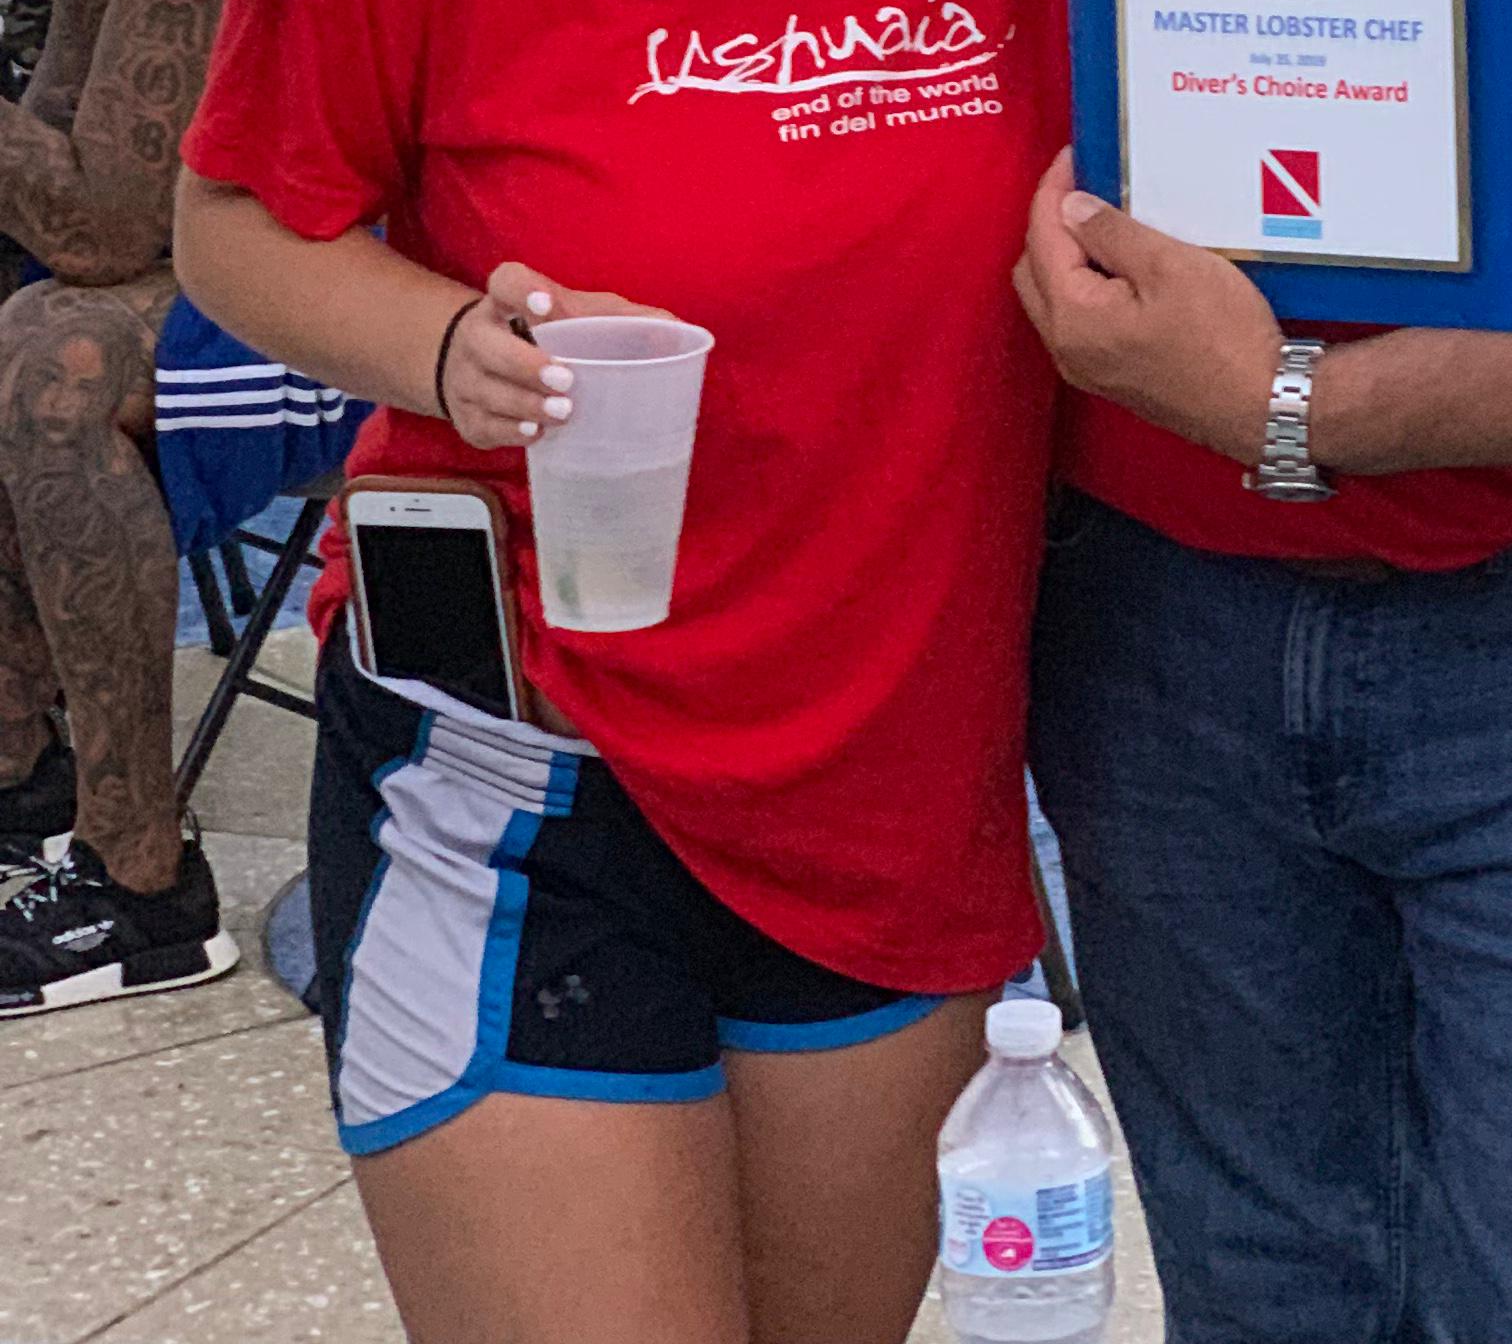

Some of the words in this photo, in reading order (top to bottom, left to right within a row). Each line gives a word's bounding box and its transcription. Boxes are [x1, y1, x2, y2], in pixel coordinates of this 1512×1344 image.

[1153, 11, 1249, 34] MASTER
[1256, 14, 1357, 39] LOBSTER
[1364, 19, 1424, 42] CHEF
[771, 94, 830, 121] end
[837, 86, 865, 108] of
[869, 85, 911, 105] the
[918, 72, 999, 100] world
[1171, 71, 1248, 95] Diver's
[1253, 75, 1328, 99] Choice
[1334, 79, 1409, 103] Award
[778, 123, 821, 143] fin
[829, 112, 876, 136] del
[885, 97, 1003, 127] mundo
